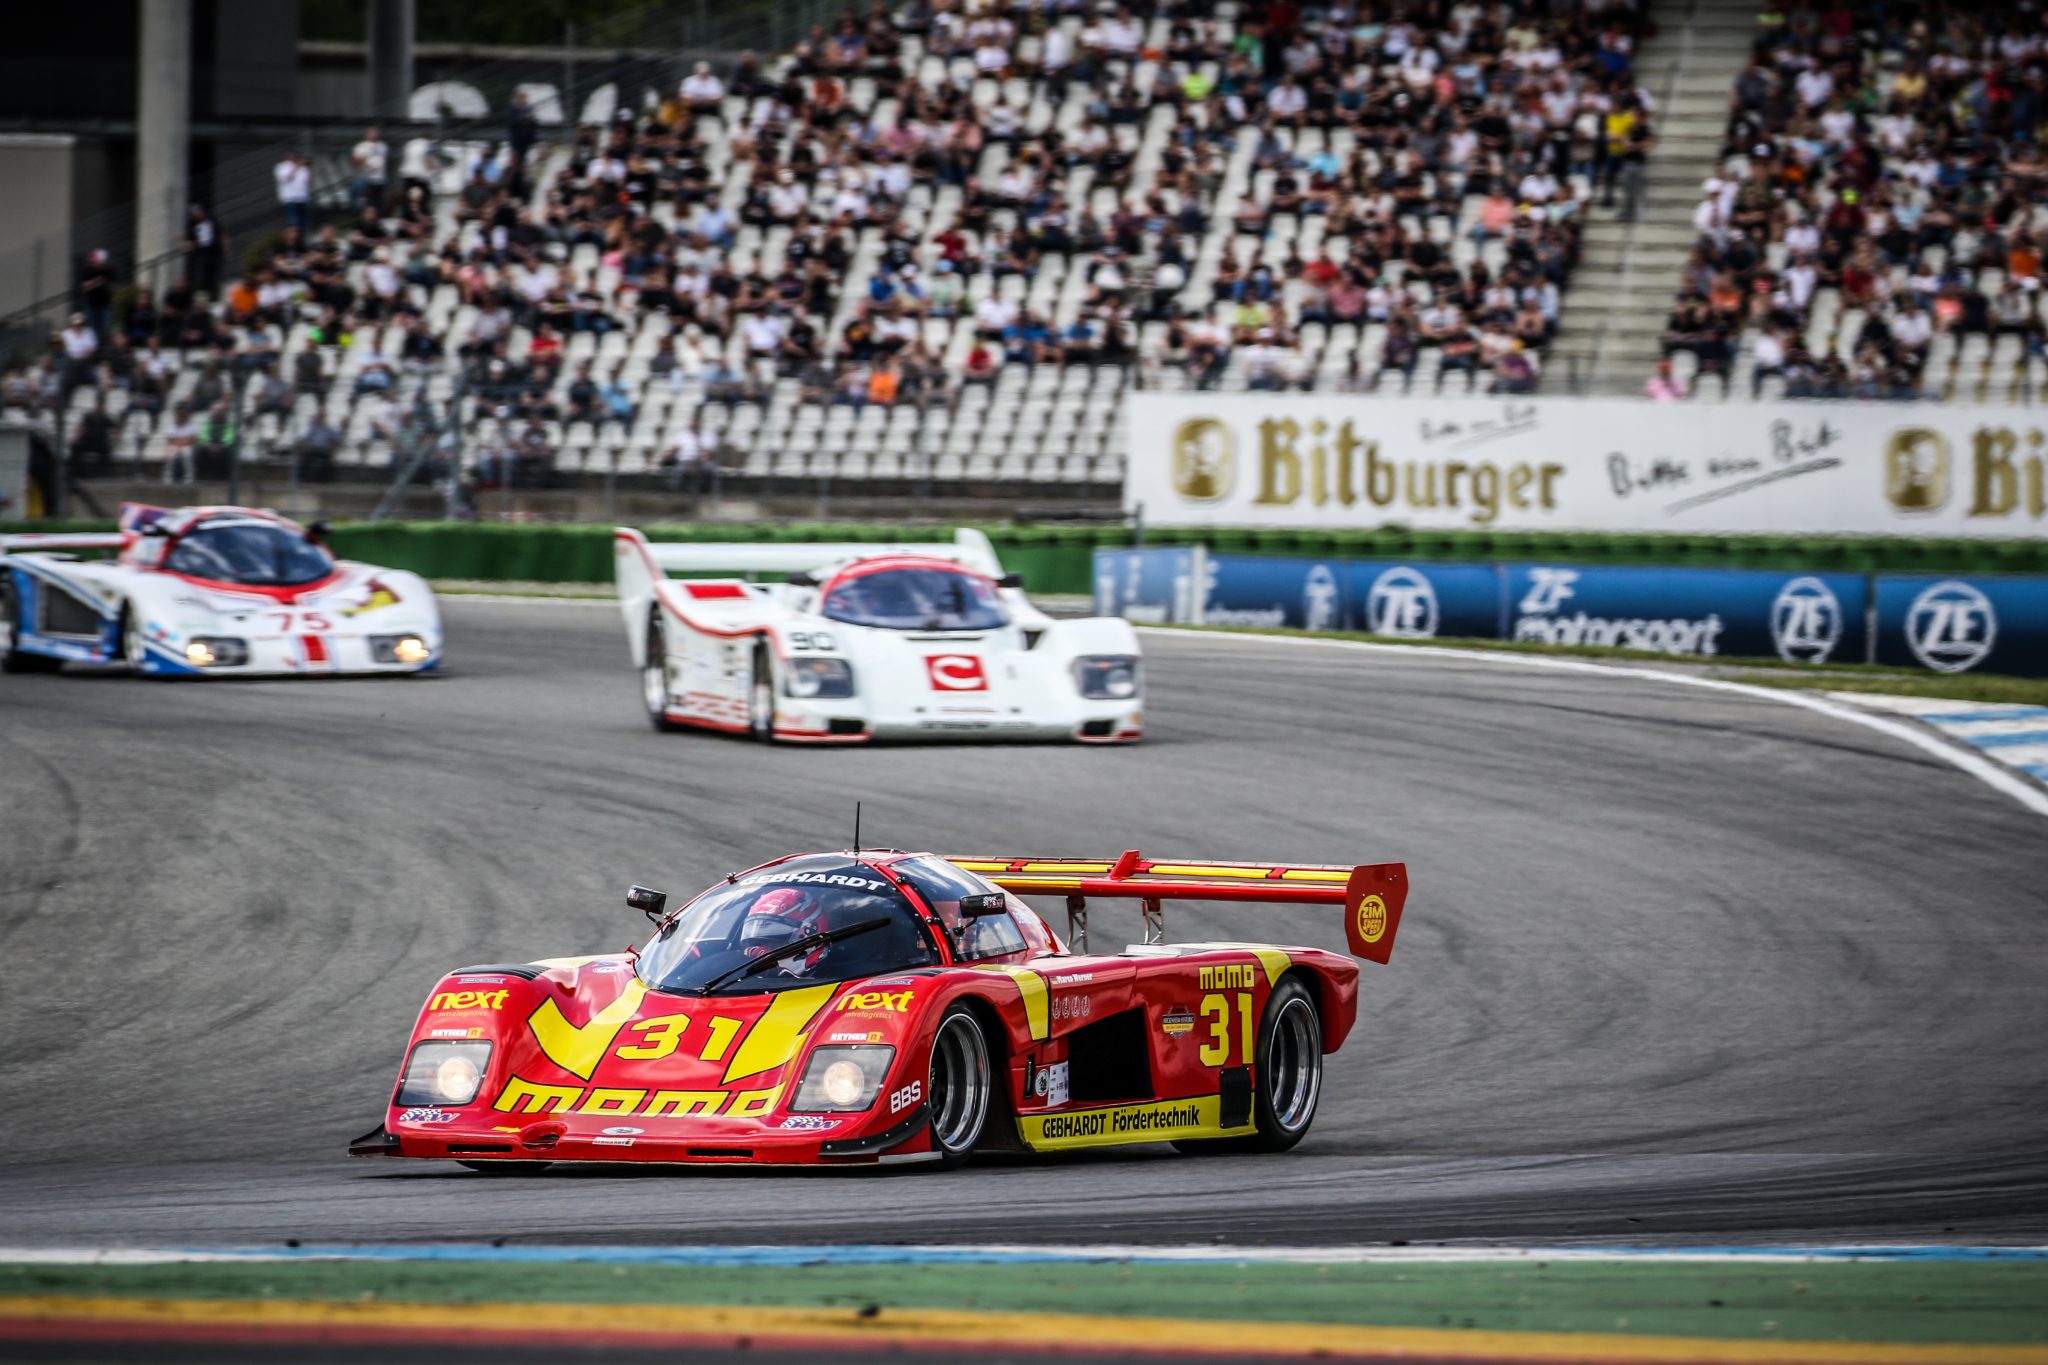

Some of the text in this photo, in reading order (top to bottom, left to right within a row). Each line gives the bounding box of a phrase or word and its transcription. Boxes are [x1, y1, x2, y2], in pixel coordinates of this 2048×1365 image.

[1254, 415, 1564, 523] Bitburger
[1519, 567, 1580, 614] ZF
[268, 612, 332, 632] 75
[1372, 582, 1431, 636] ZF
[1779, 595, 1836, 648] ZF
[1915, 597, 1992, 650] ZF
[1514, 611, 1724, 656] motorsport
[739, 873, 886, 891] GEBHARDT
[1199, 965, 1255, 989] momo
[429, 990, 509, 1010] next
[836, 991, 915, 1012] next
[844, 1011, 893, 1019] intralogistics
[431, 1029, 467, 1037] REYHER
[615, 1013, 743, 1060] 31
[830, 1033, 867, 1041] REYHER
[1199, 992, 1254, 1067] 31
[492, 1074, 786, 1118] momo
[890, 1080, 921, 1114] BBS
[1043, 1105, 1200, 1138] GEBHARDT Fördertechnik
